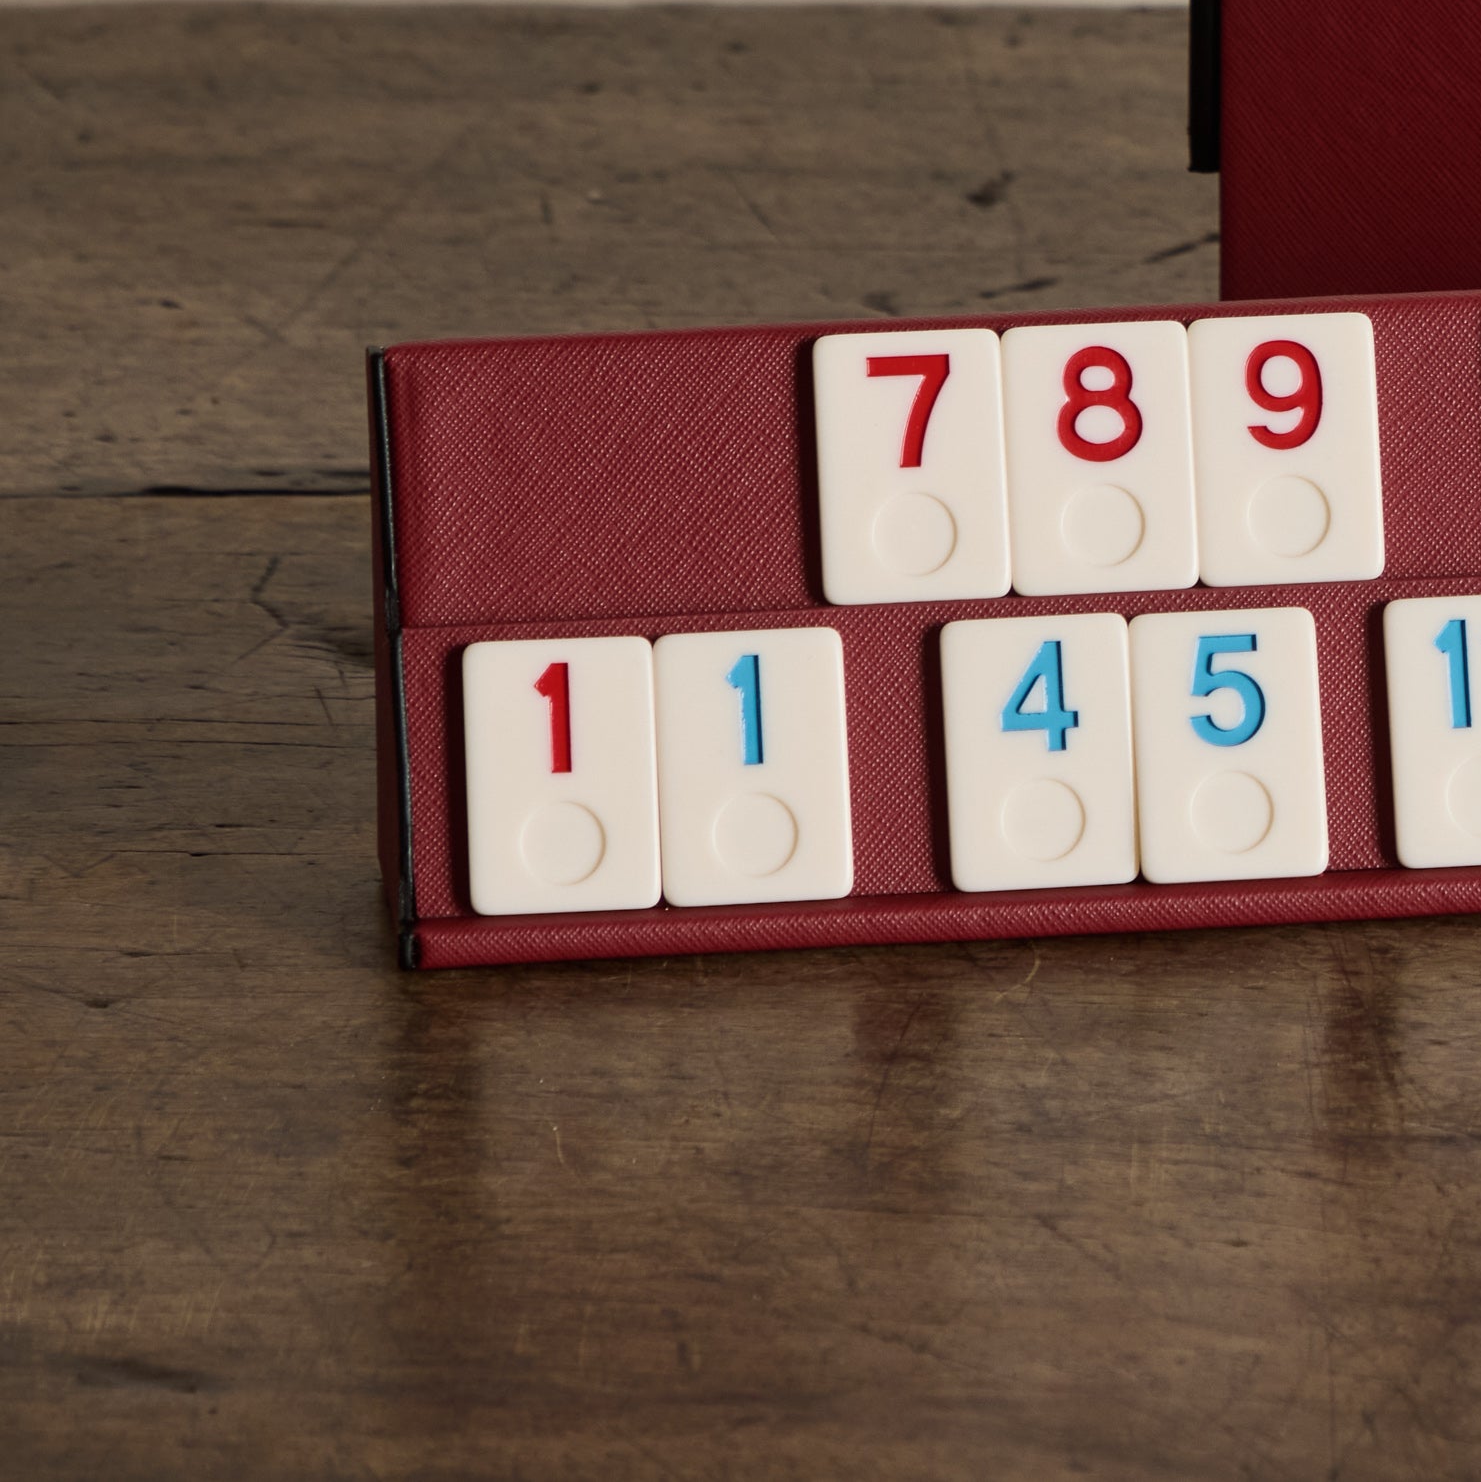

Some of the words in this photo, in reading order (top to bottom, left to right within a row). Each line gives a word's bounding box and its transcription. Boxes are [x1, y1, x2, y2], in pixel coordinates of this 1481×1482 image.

[865, 353, 951, 469] 7
[1056, 345, 1144, 463] 8
[1244, 339, 1324, 451] 9
[533, 661, 573, 774] 1
[726, 654, 767, 766] 1
[1001, 640, 1080, 752] 4
[1189, 633, 1267, 746] 5
